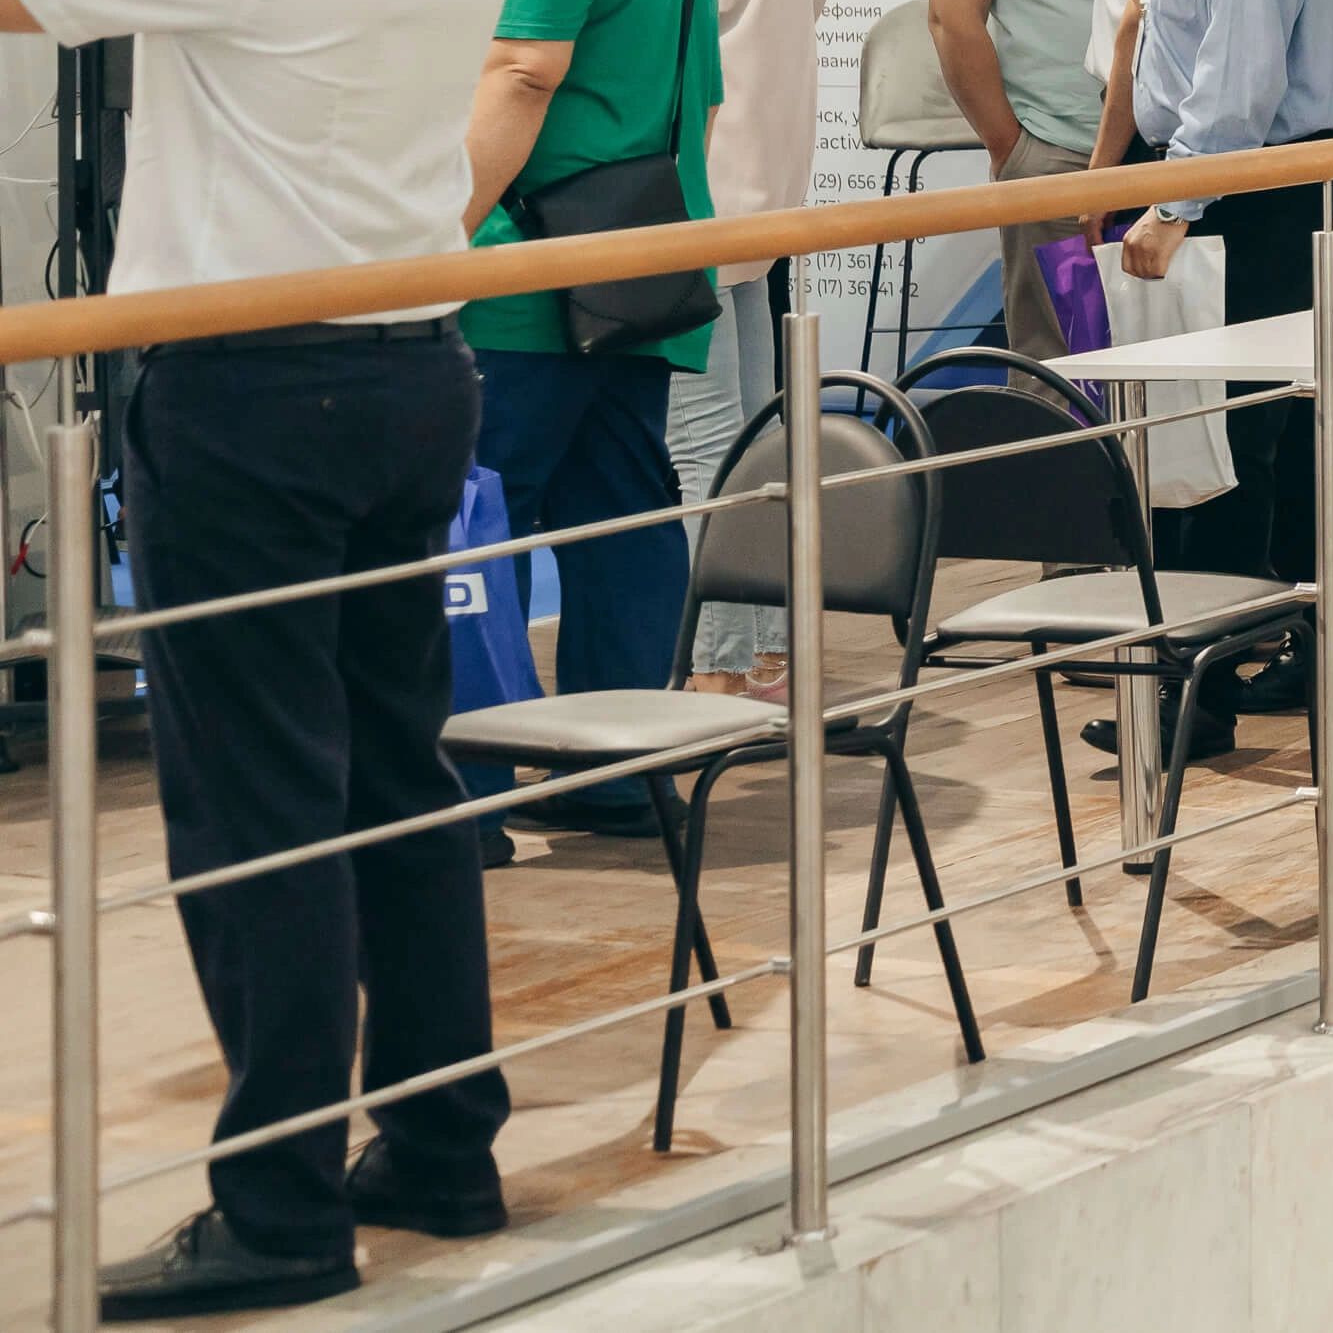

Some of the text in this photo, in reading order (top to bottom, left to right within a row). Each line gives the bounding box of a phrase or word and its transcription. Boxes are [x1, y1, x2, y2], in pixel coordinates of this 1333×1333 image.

[821, 2, 882, 21] ефония
[813, 172, 842, 191] (29)
[847, 174, 876, 190] 656
[816, 252, 842, 271] (17)
[817, 277, 843, 297] (17)
